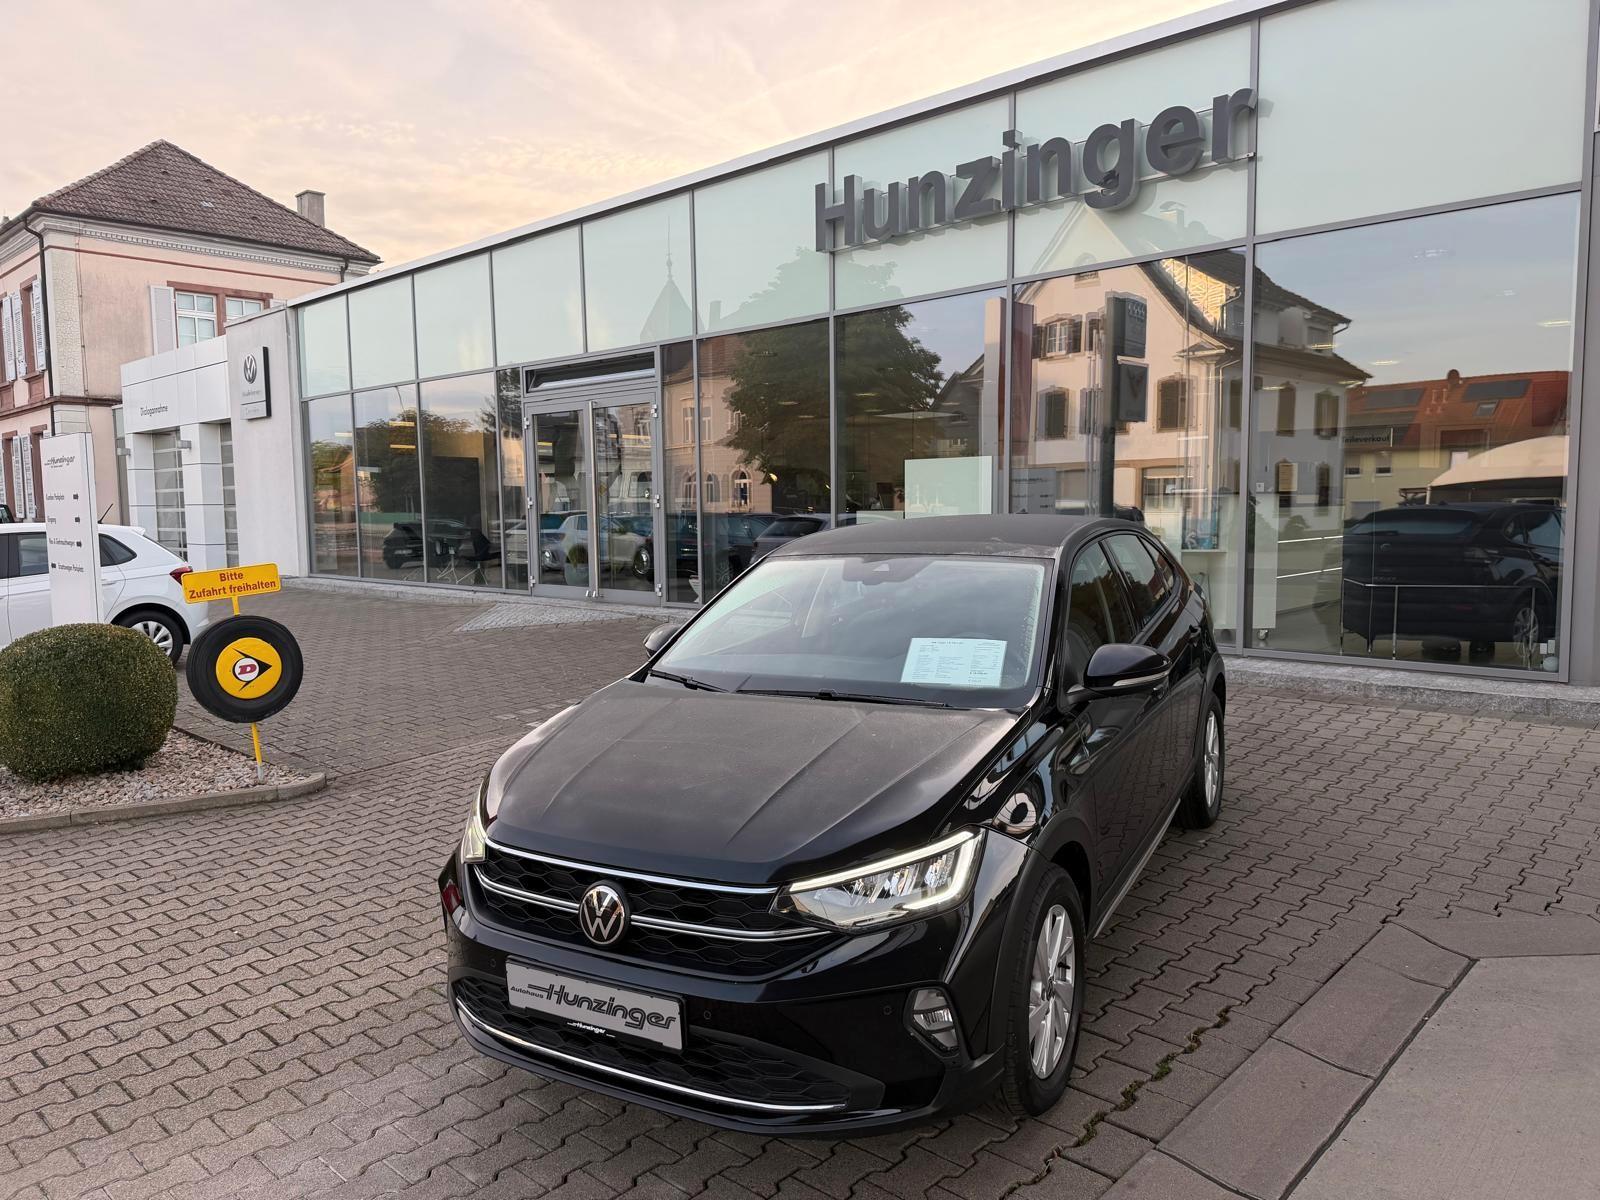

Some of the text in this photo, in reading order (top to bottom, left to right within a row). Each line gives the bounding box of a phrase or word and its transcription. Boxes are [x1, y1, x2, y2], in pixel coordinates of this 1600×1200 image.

[815, 87, 1257, 252] Hunzinger
[219, 571, 244, 582] Bitte
[188, 580, 277, 600] Zufahrt freihalten
[238, 663, 258, 676] D
[510, 983, 677, 1030] Autohaus Hunzinger
